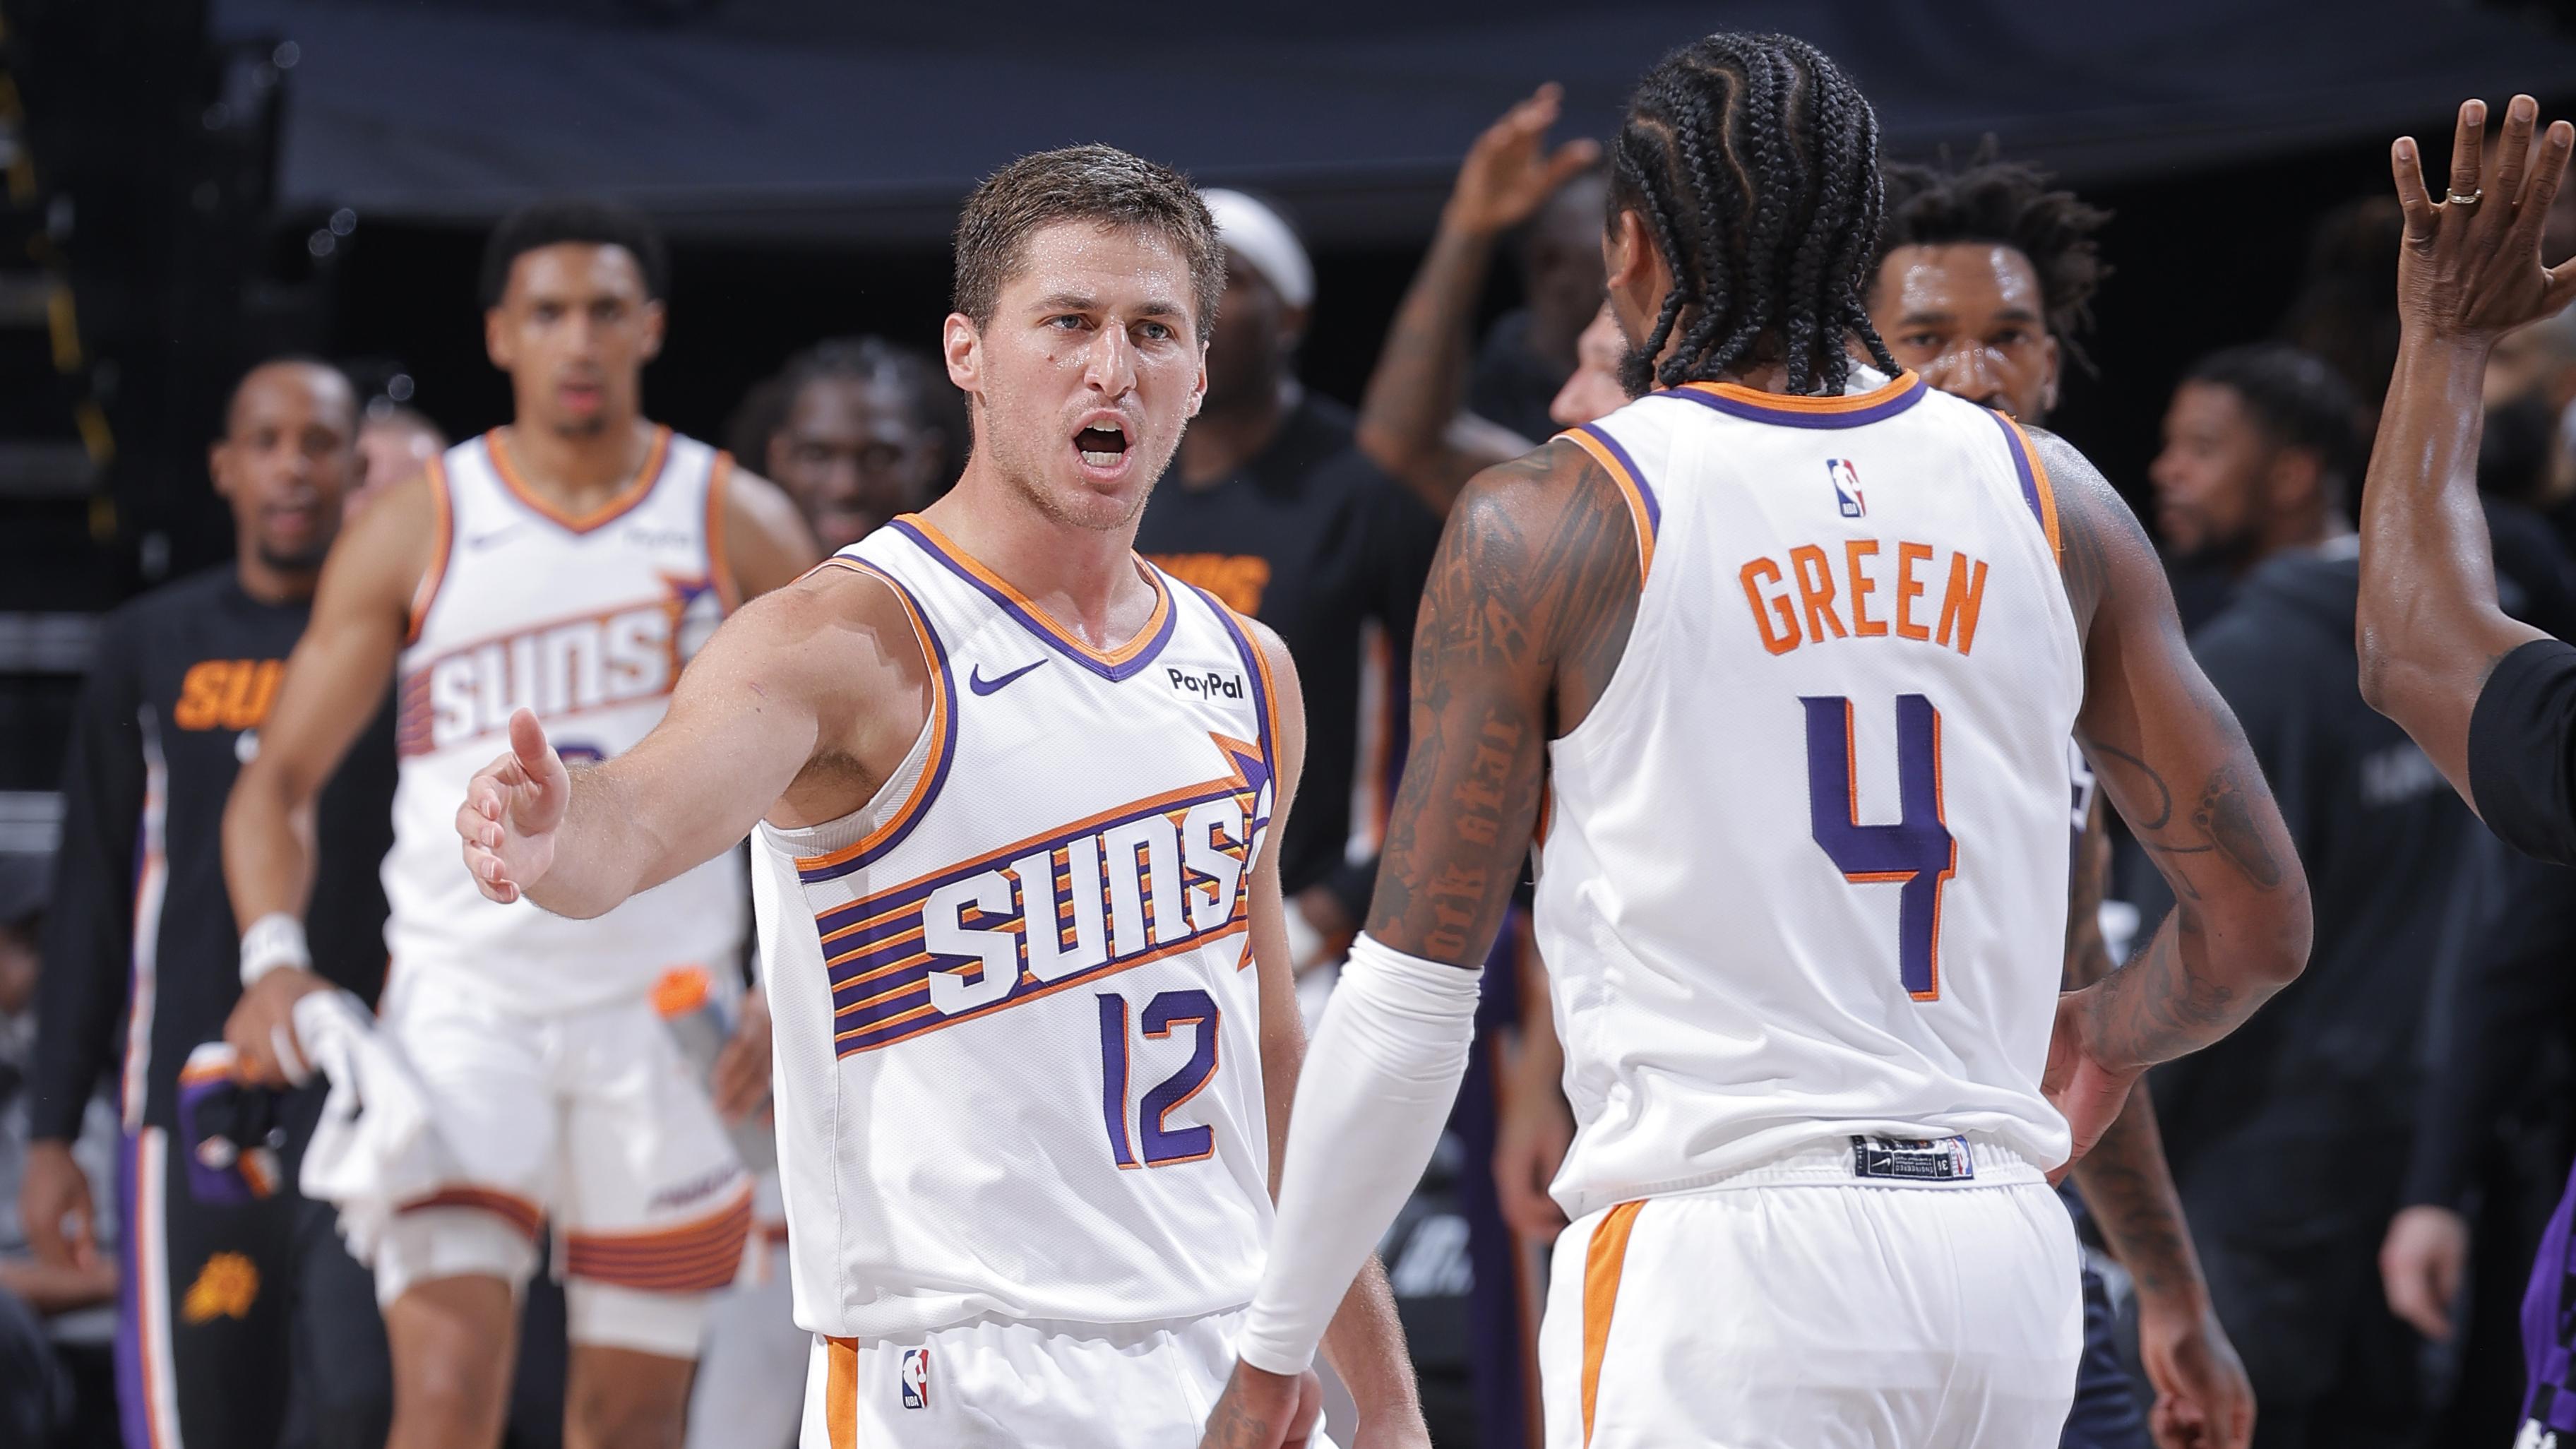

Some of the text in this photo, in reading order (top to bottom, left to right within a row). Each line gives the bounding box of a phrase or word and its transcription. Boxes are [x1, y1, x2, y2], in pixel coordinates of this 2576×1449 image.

[1739, 539, 1988, 655] GREEN
[174, 659, 284, 730] SU
[430, 605, 672, 747] SUNS
[1167, 668, 1244, 700] PayPal
[922, 797, 1244, 1015] SUNS
[1796, 694, 1957, 1001] 4
[1095, 989, 1220, 1169] 12
[905, 1395, 919, 1407] NBA
